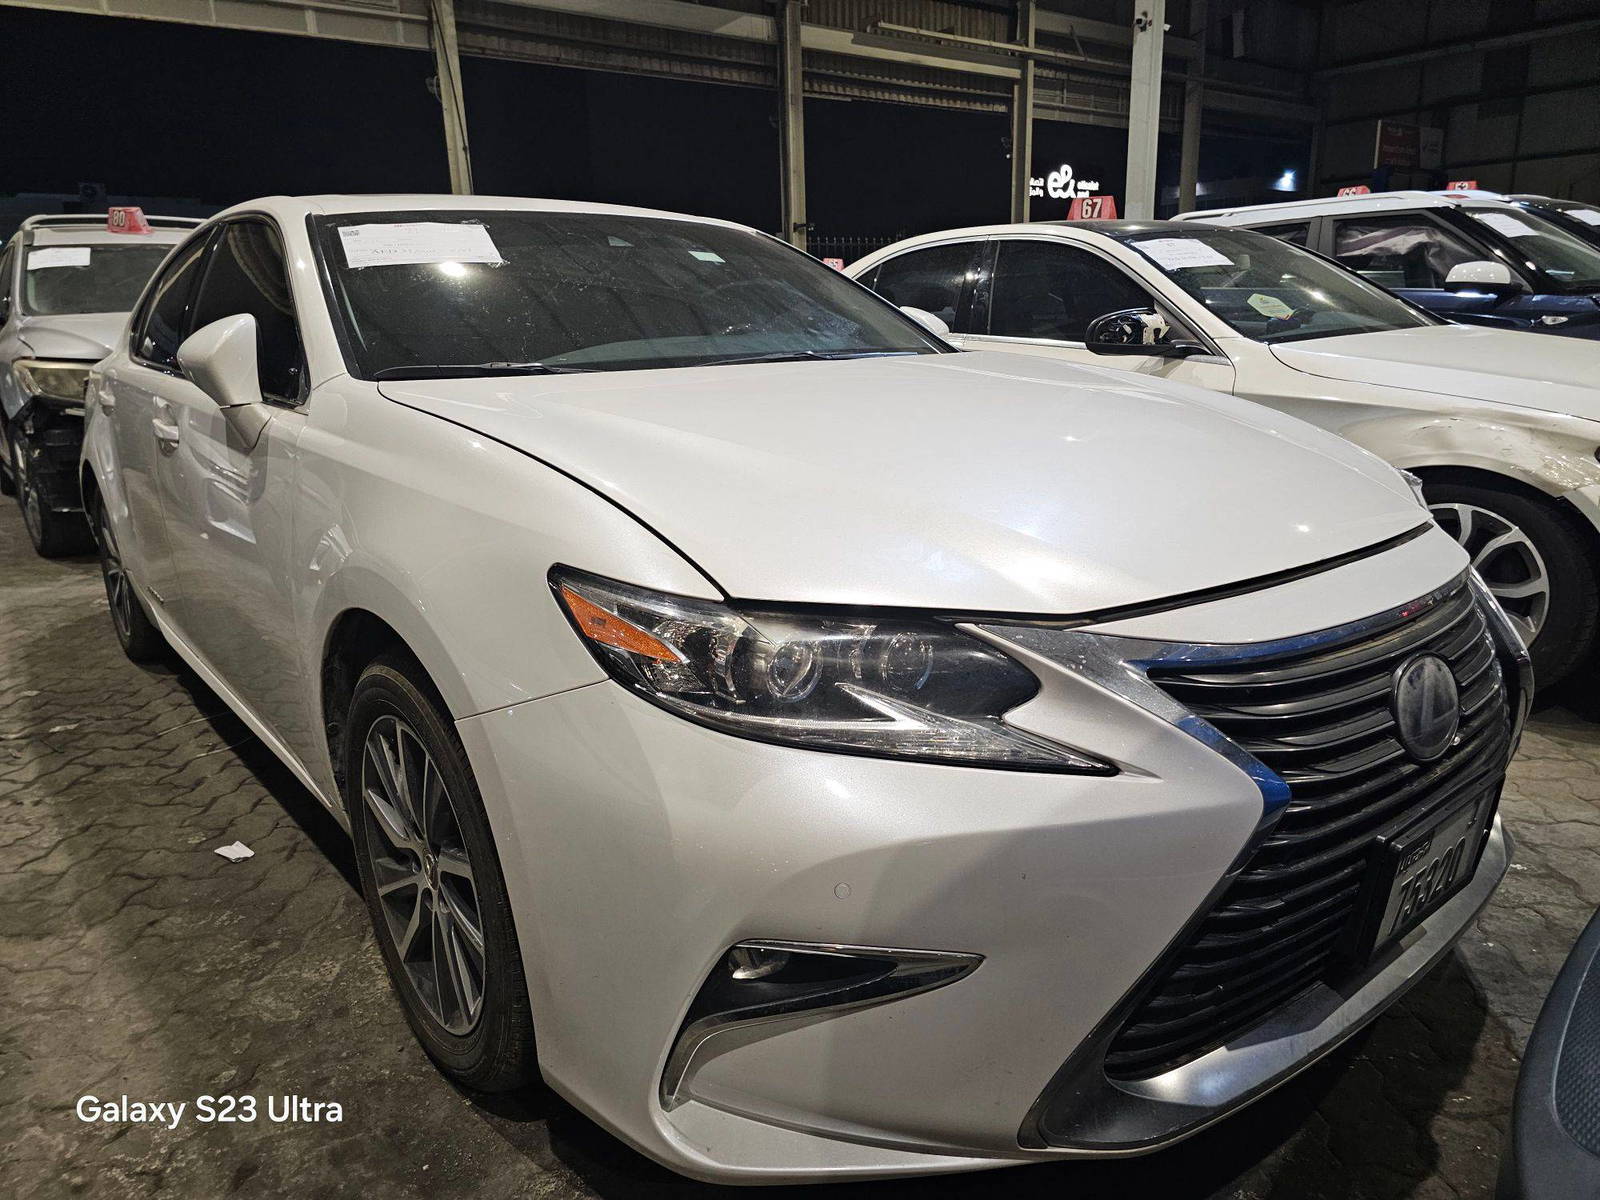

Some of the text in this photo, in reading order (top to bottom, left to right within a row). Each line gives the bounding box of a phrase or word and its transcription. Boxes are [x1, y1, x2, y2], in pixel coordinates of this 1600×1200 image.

[112, 210, 126, 227] 80
[1082, 198, 1102, 219] 67
[1388, 835, 1467, 936] 75320
